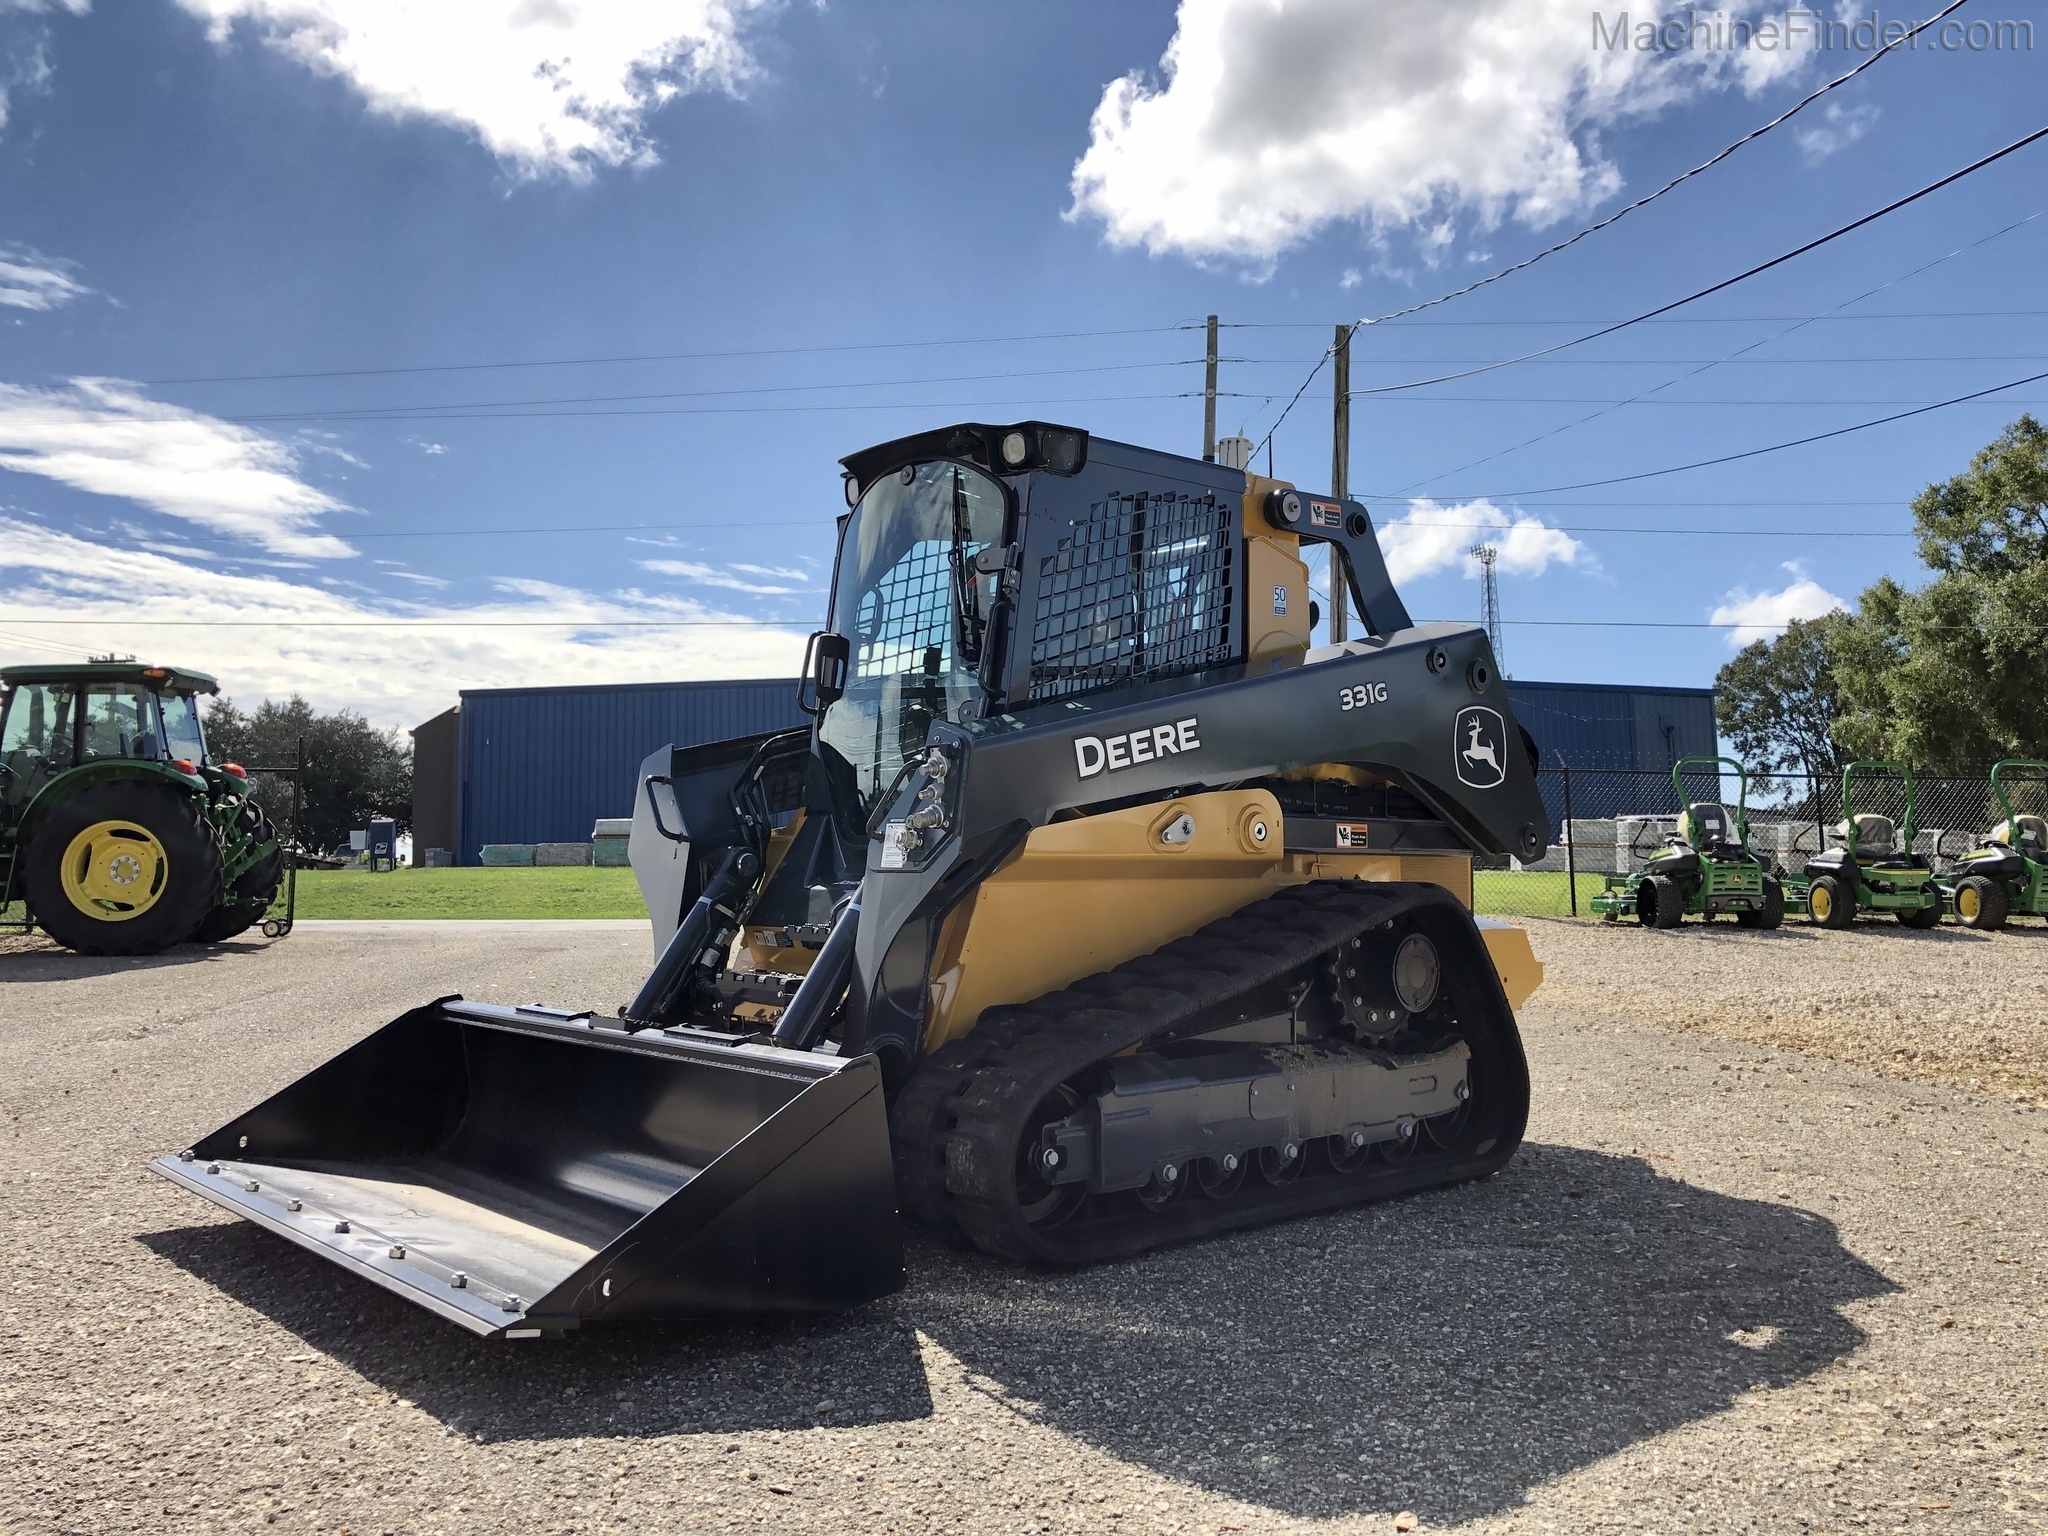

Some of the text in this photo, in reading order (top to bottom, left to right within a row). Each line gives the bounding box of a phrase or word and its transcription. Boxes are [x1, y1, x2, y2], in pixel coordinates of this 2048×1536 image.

[1274, 587, 1286, 602] 50
[1339, 682, 1388, 711] 331G
[1074, 717, 1201, 778] DEERE
